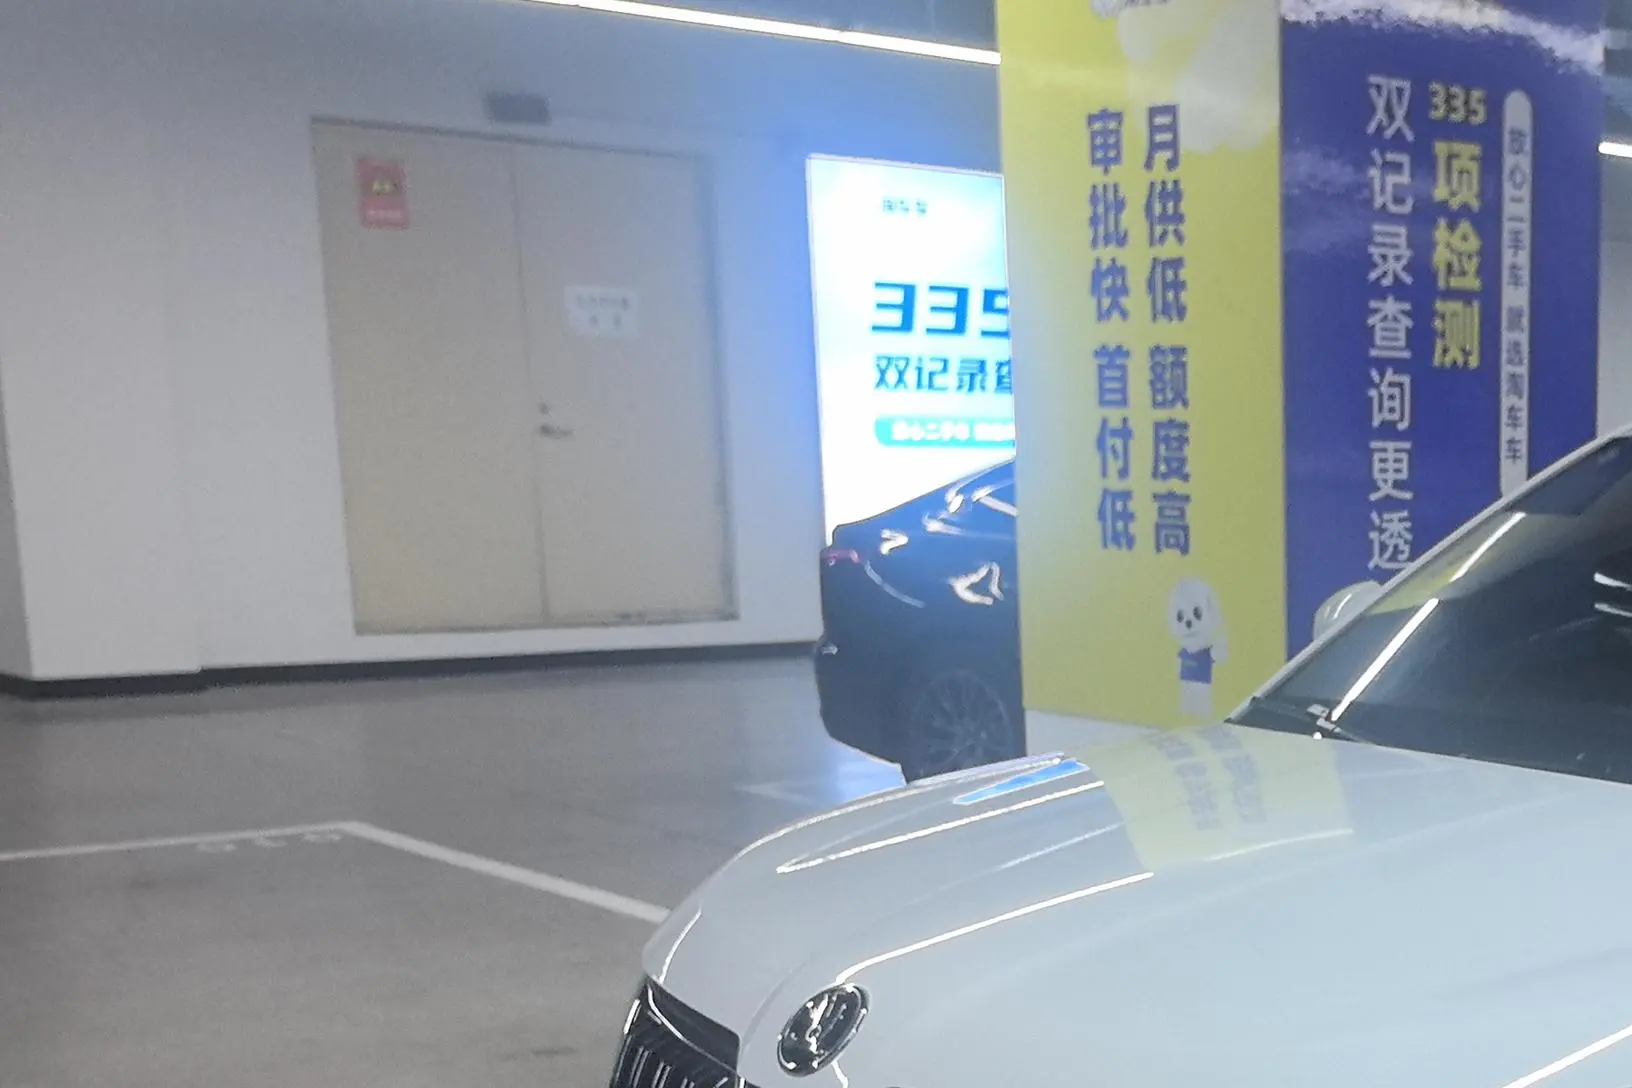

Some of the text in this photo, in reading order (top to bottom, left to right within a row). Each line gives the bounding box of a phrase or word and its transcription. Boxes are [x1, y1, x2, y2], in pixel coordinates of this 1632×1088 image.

[1086, 108, 1136, 551] 审批快 首付低
[1144, 104, 1192, 556] 月供低 额度高
[1366, 74, 1415, 571] 双记录查询更透
[1428, 80, 1488, 370] 335项检测
